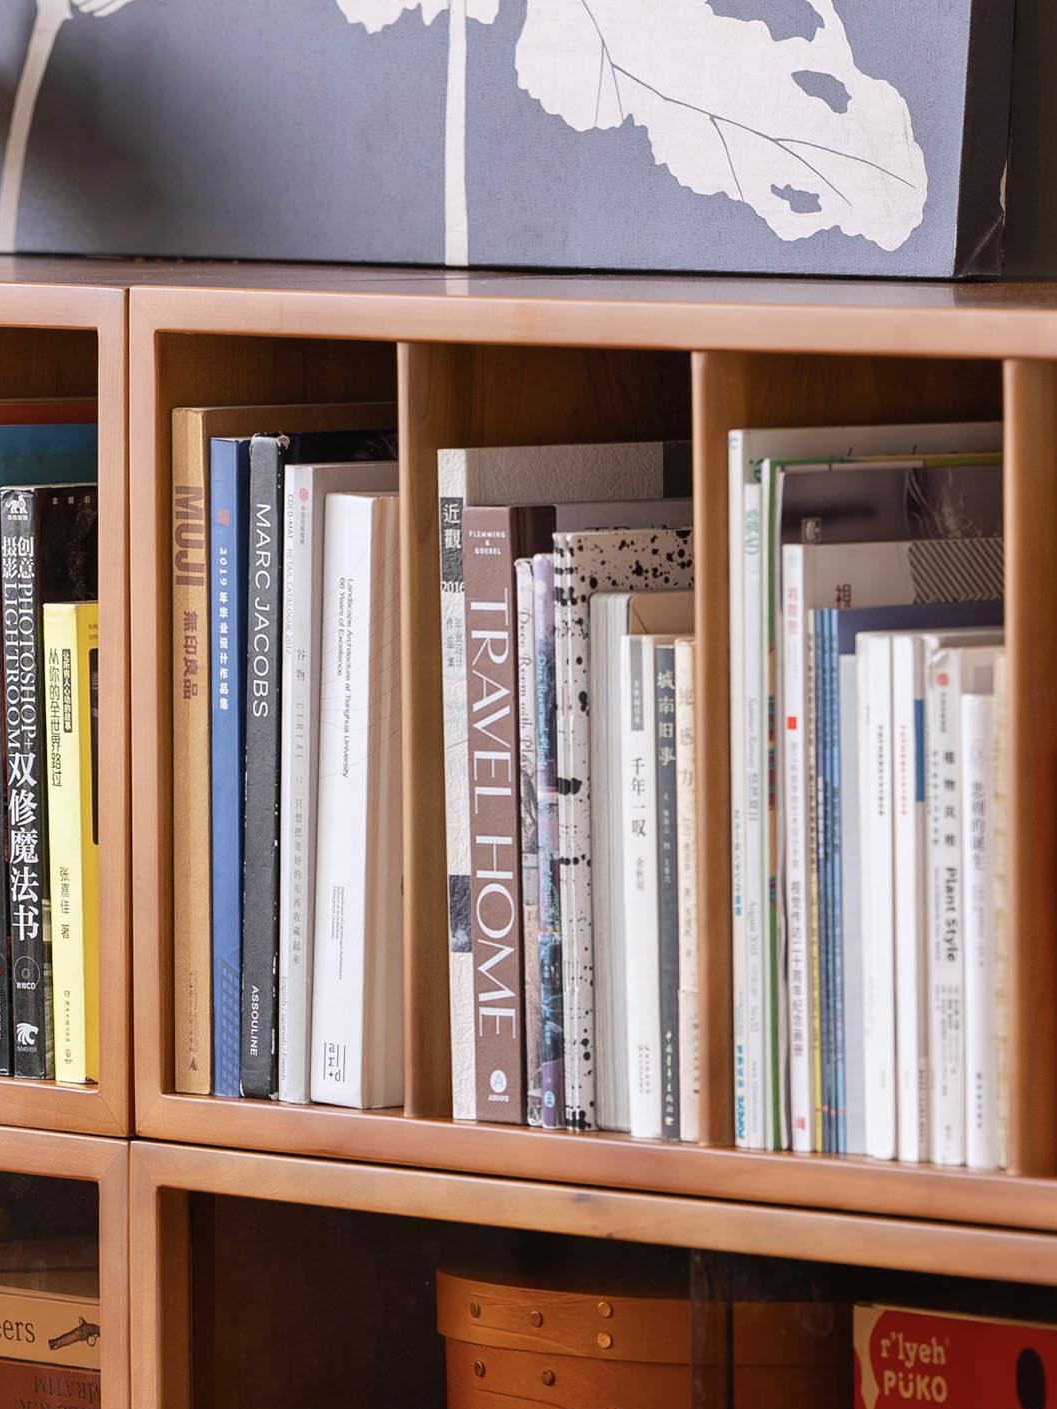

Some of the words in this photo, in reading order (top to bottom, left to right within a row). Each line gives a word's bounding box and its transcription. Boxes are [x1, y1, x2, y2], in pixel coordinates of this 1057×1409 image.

[174, 484, 207, 587] MUJI
[255, 503, 272, 590] MARC
[442, 502, 462, 550] 近觀
[468, 529, 507, 539] FLEMMING
[474, 546, 502, 556] GOEBEL
[2, 535, 19, 580] 摄影
[285, 581, 294, 635] CATALOGUE
[338, 617, 345, 628] of
[344, 577, 355, 628] Landscape
[518, 608, 533, 648] Deco
[4, 580, 21, 750] LIGHTROOM
[182, 610, 199, 700] 無印良品
[252, 596, 271, 718] JACOBS
[336, 629, 345, 677] Excellence
[343, 629, 354, 681] Architecture
[519, 653, 534, 697] Room
[344, 682, 352, 693] at
[469, 586, 512, 815] TRAVEL
[48, 647, 62, 788] 从你的全世界路过
[294, 702, 304, 760] CEREAL
[342, 694, 353, 737] Tsinghua
[520, 701, 534, 731] with
[657, 669, 676, 767] 城南旧事
[340, 738, 352, 779] University
[630, 756, 647, 838] 千年一叹
[7, 751, 40, 942] 双修魔法书
[59, 866, 71, 915] 张嘉佳
[944, 866, 959, 917] Plant
[475, 835, 517, 1040] HOME
[945, 919, 958, 963] Style
[249, 984, 261, 1057] ASSOULINE
[880, 1332, 947, 1369] r'lyeh
[883, 1370, 948, 1403] PÜKO
